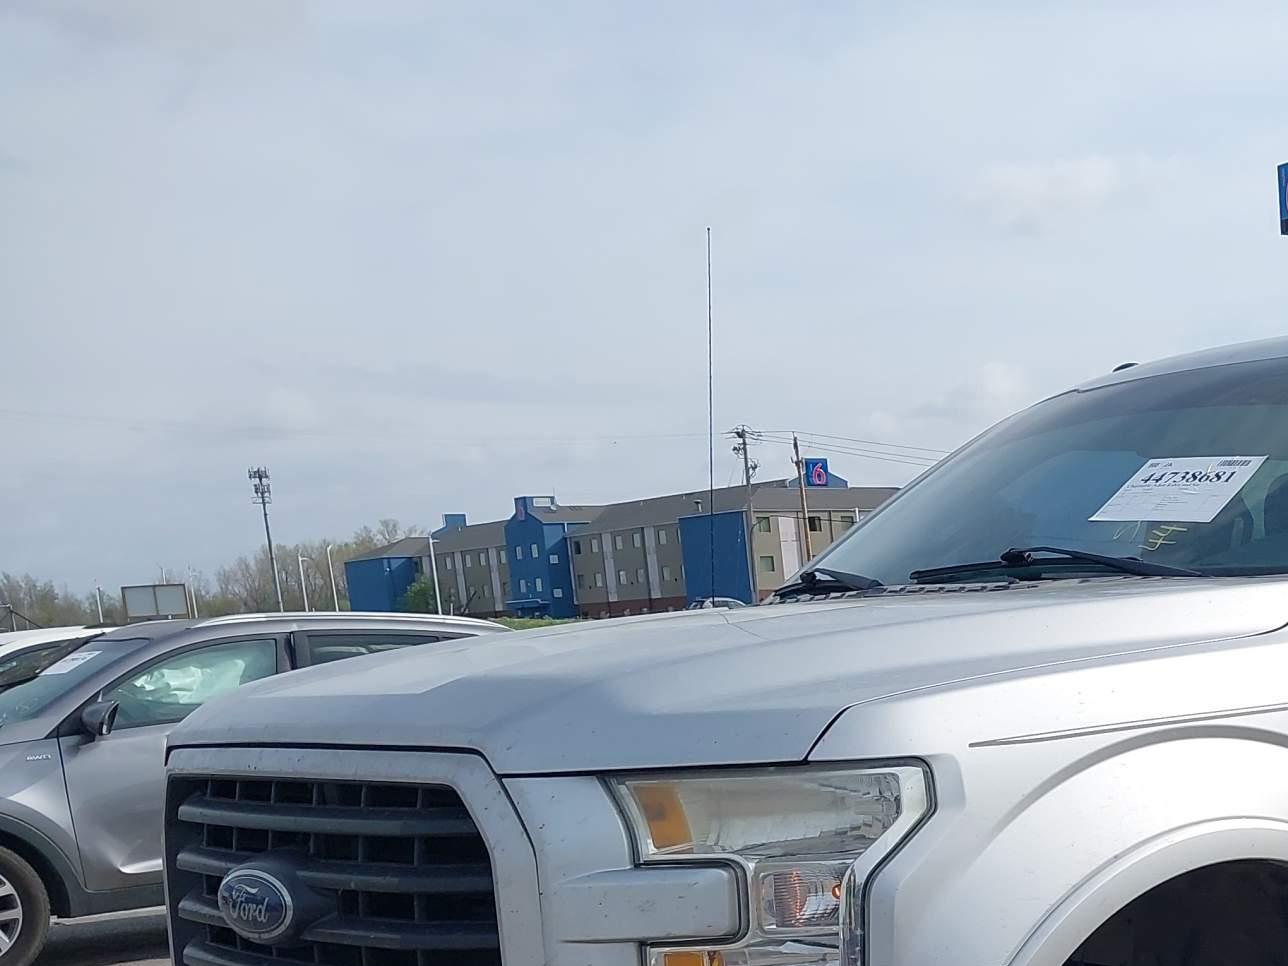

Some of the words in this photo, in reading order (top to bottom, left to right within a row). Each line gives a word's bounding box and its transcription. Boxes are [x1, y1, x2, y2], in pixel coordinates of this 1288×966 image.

[812, 463, 826, 485] 6
[1140, 471, 1237, 484] 44738681
[229, 884, 269, 922] Ford
